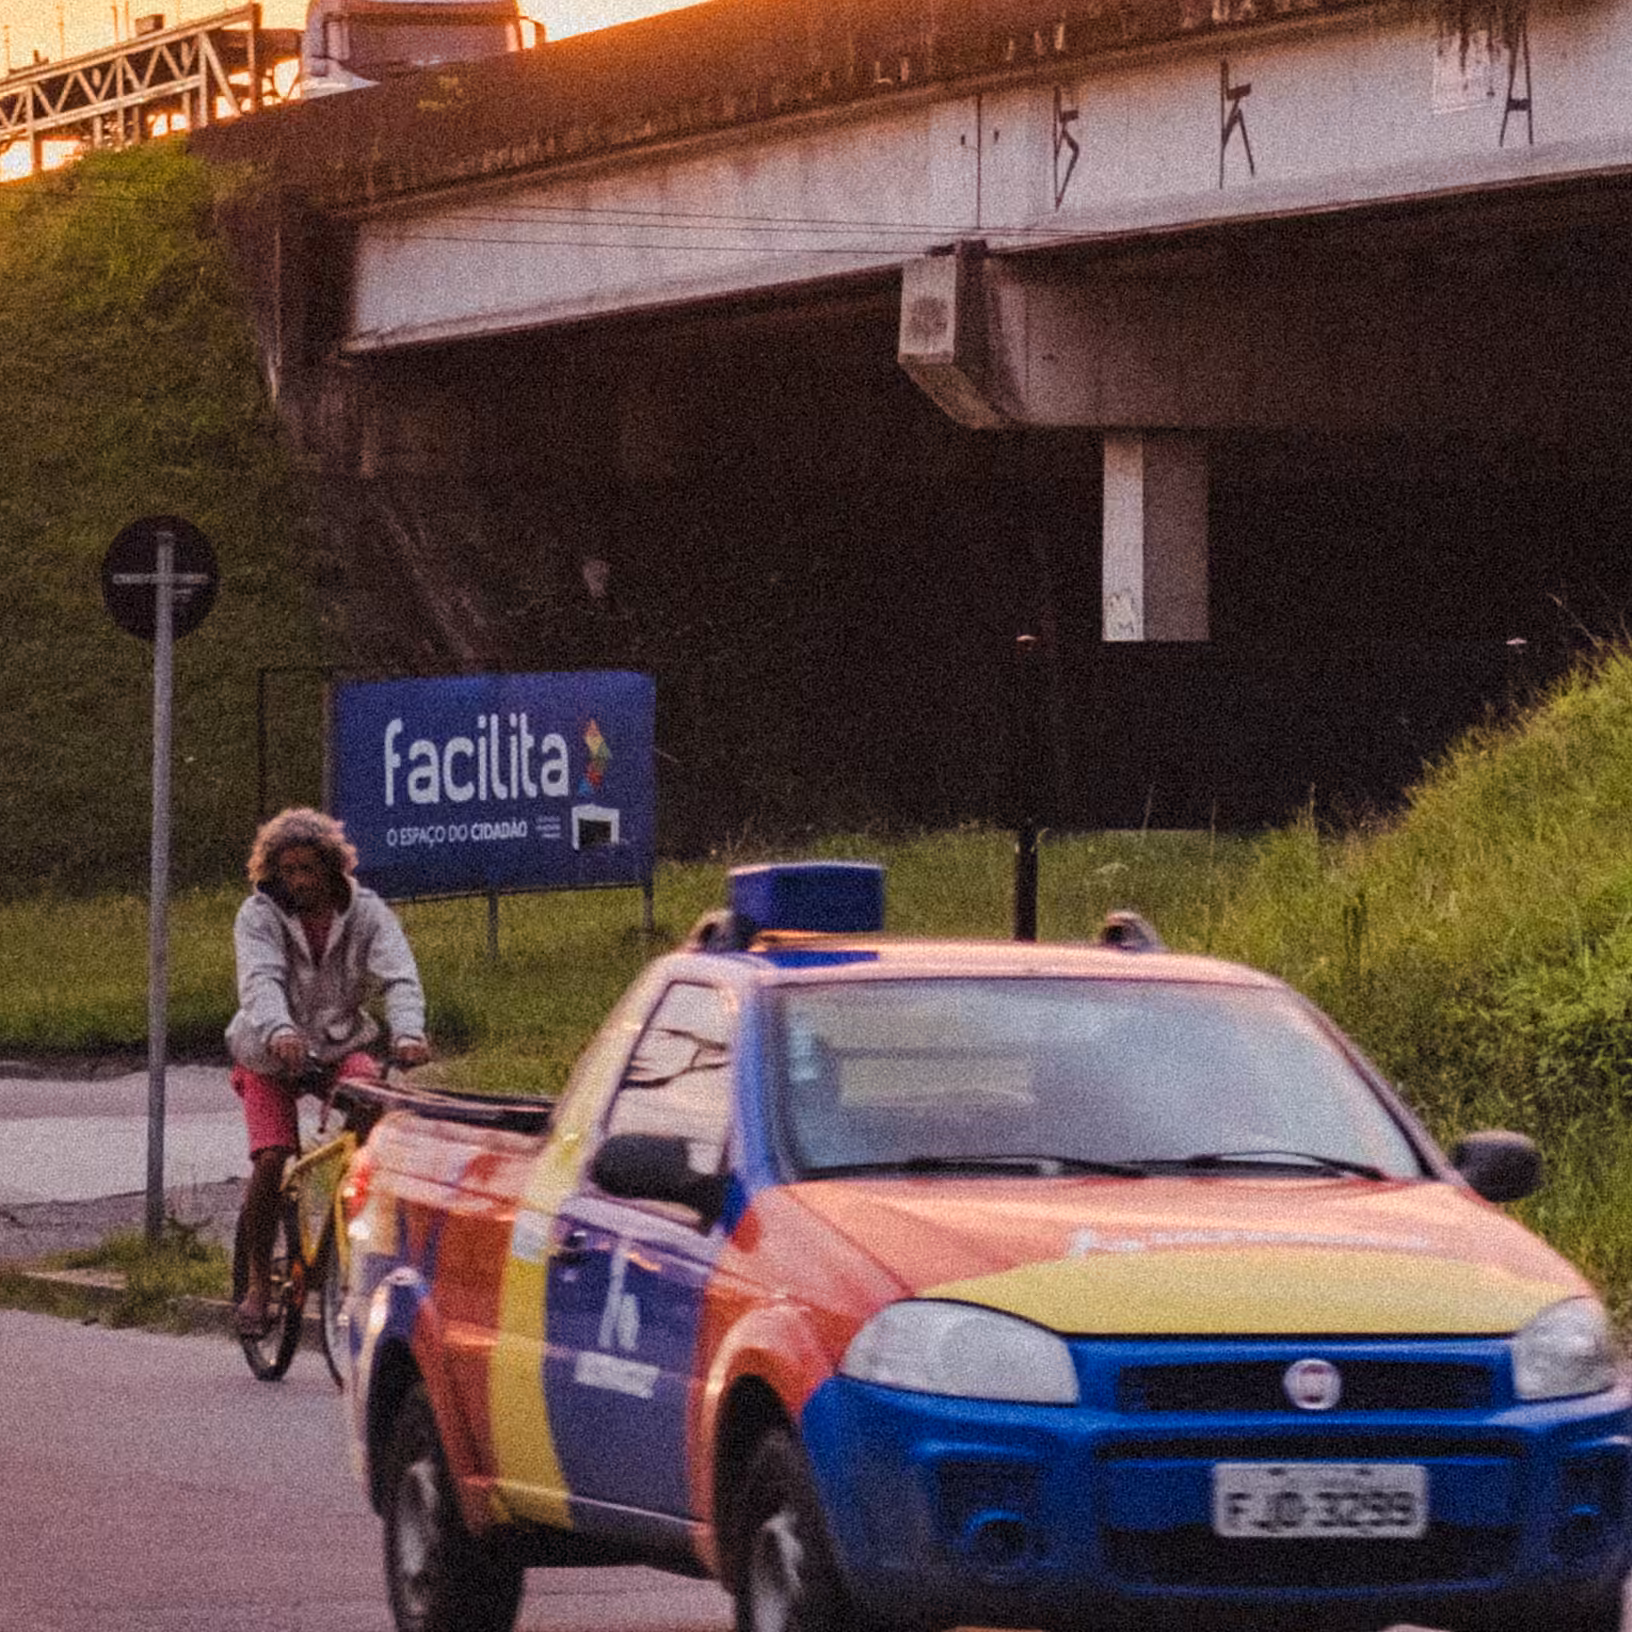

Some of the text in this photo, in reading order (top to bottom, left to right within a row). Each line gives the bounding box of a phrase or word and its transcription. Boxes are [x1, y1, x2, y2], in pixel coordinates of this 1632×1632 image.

[384, 713, 569, 806] facilita
[386, 828, 398, 846] O
[400, 824, 445, 848] ESPAÇO
[448, 824, 468, 843] DO
[470, 817, 528, 840] CIDADÃO
